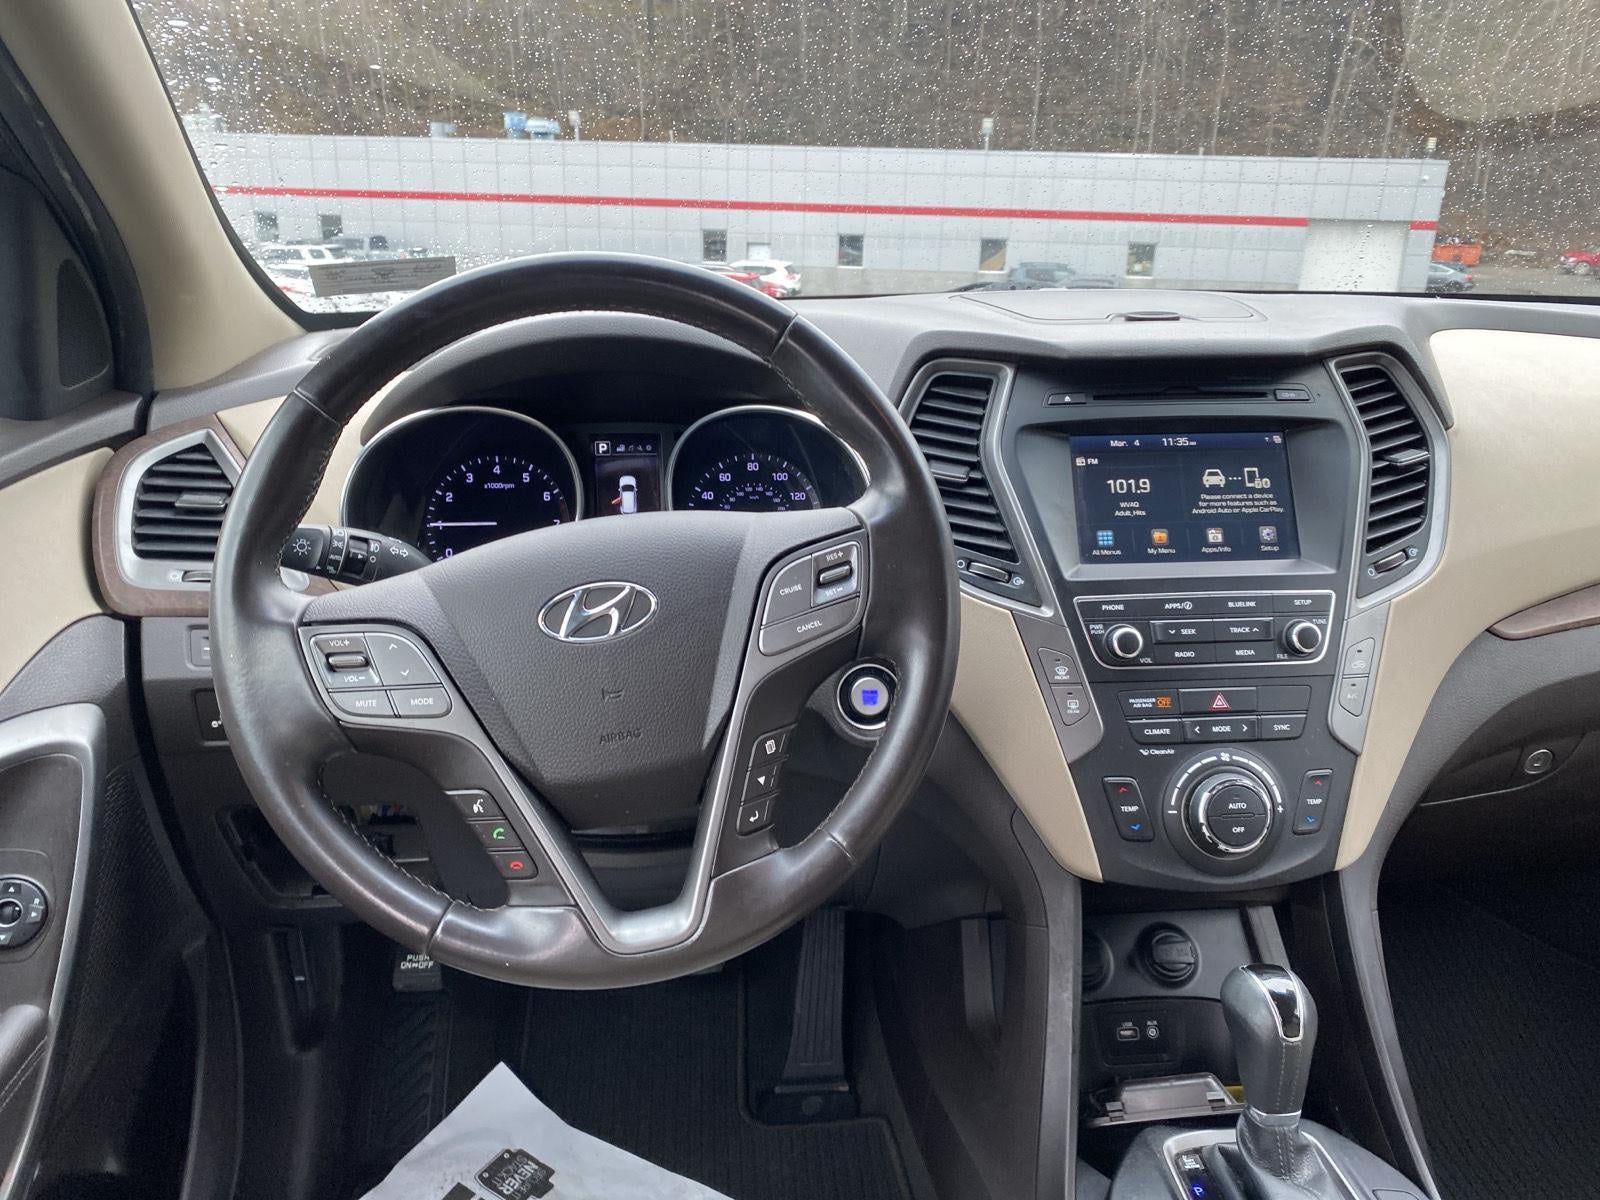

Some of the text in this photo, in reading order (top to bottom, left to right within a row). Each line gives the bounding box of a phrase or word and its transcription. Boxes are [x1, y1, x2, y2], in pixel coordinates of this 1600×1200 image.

[598, 443, 608, 454] P
[493, 464, 500, 474] 4
[747, 462, 758, 471] 80
[466, 473, 474, 483] 3
[522, 472, 530, 482] 5
[719, 473, 731, 482] 60
[772, 472, 788, 480] 100
[1106, 478, 1150, 494] 101.9
[446, 492, 453, 502] 2
[543, 491, 550, 501] 6
[702, 492, 714, 500] 40
[790, 492, 806, 500] 120
[446, 548, 453, 558] 0
[1148, 548, 1157, 556] My
[780, 584, 802, 596] CRUISE
[796, 620, 822, 633] CANCEL
[410, 698, 434, 706] MODE
[600, 728, 642, 744] AIRBAG
[401, 961, 411, 969] ON
[500, 1160, 539, 1195] NEVER
[1194, 1187, 1203, 1196] P
